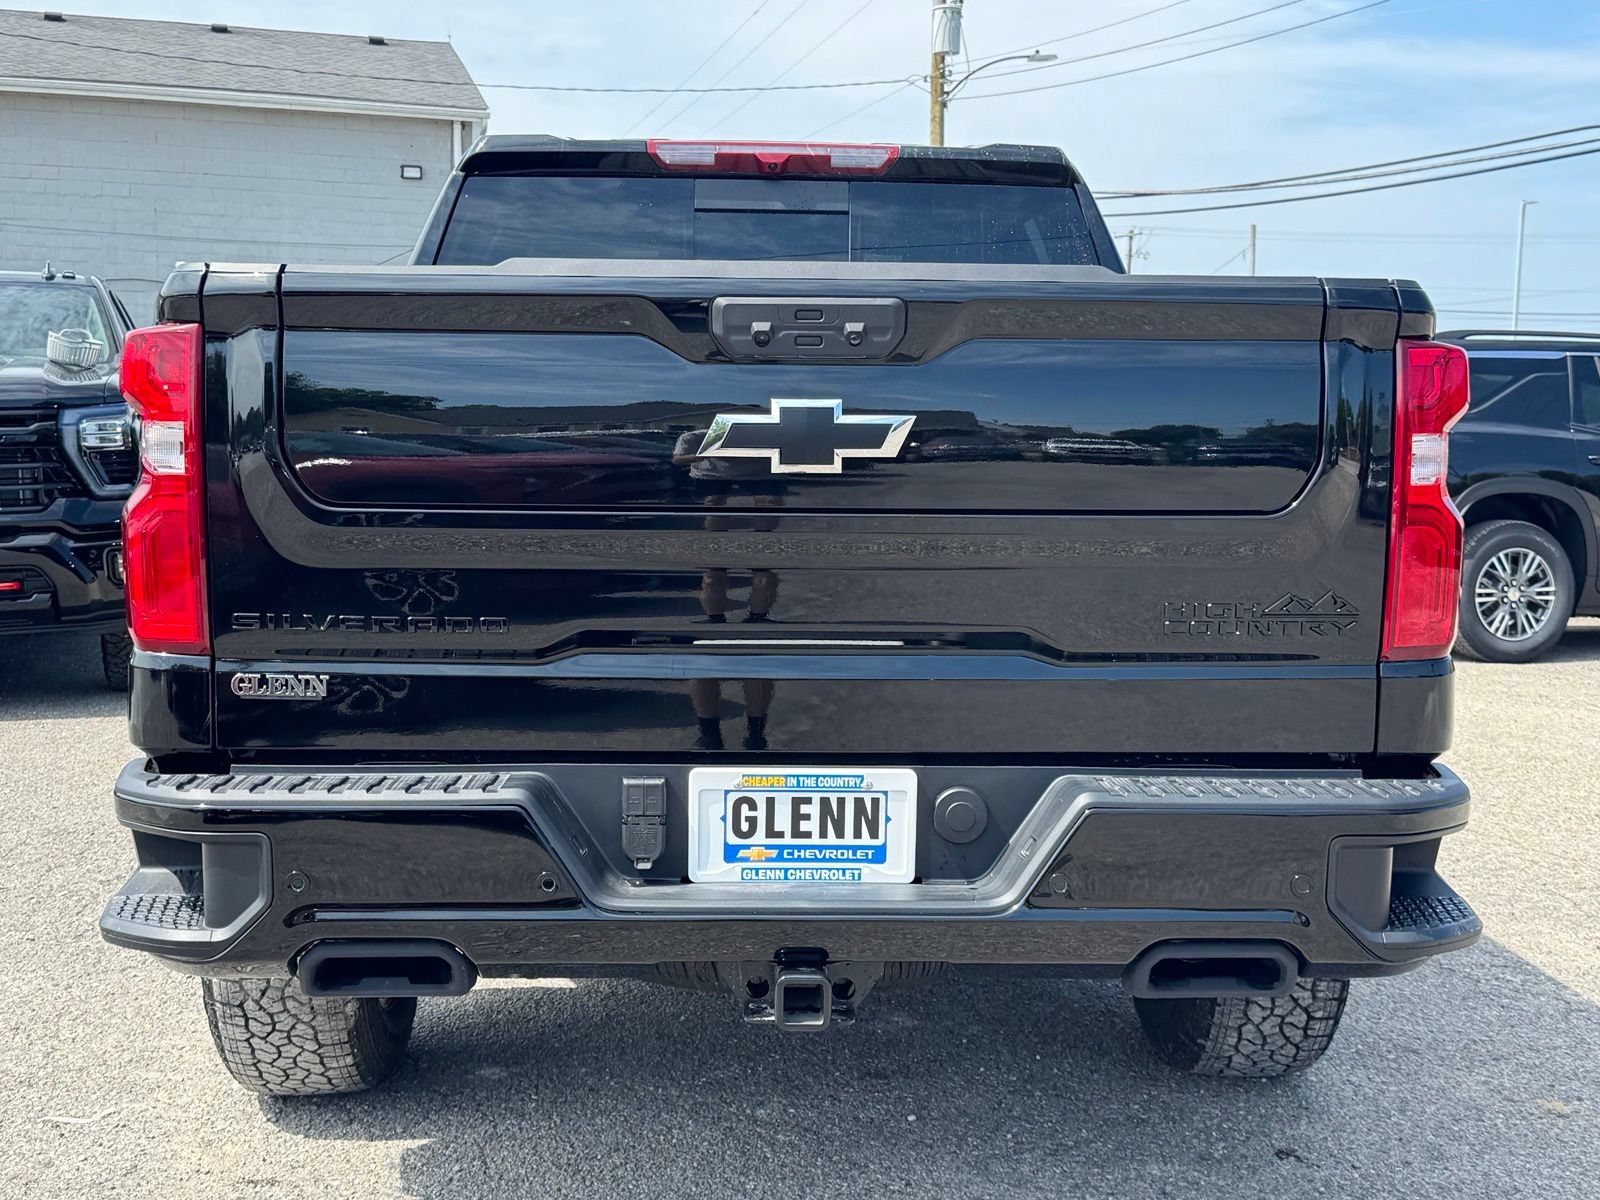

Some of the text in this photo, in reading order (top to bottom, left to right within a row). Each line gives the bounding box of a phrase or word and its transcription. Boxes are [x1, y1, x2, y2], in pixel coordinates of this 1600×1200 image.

[1164, 602, 1261, 618] HIGH
[232, 612, 510, 633] SILVERADO
[1163, 620, 1358, 636] COUNTRY
[231, 672, 329, 698] GLENN
[742, 777, 786, 787] CHEAPER
[787, 777, 797, 787] IN
[798, 777, 817, 787] THE
[731, 795, 880, 840] GLENN
[783, 850, 875, 859] CHEVROLET
[742, 868, 861, 880] GLENN CHEVROLET
